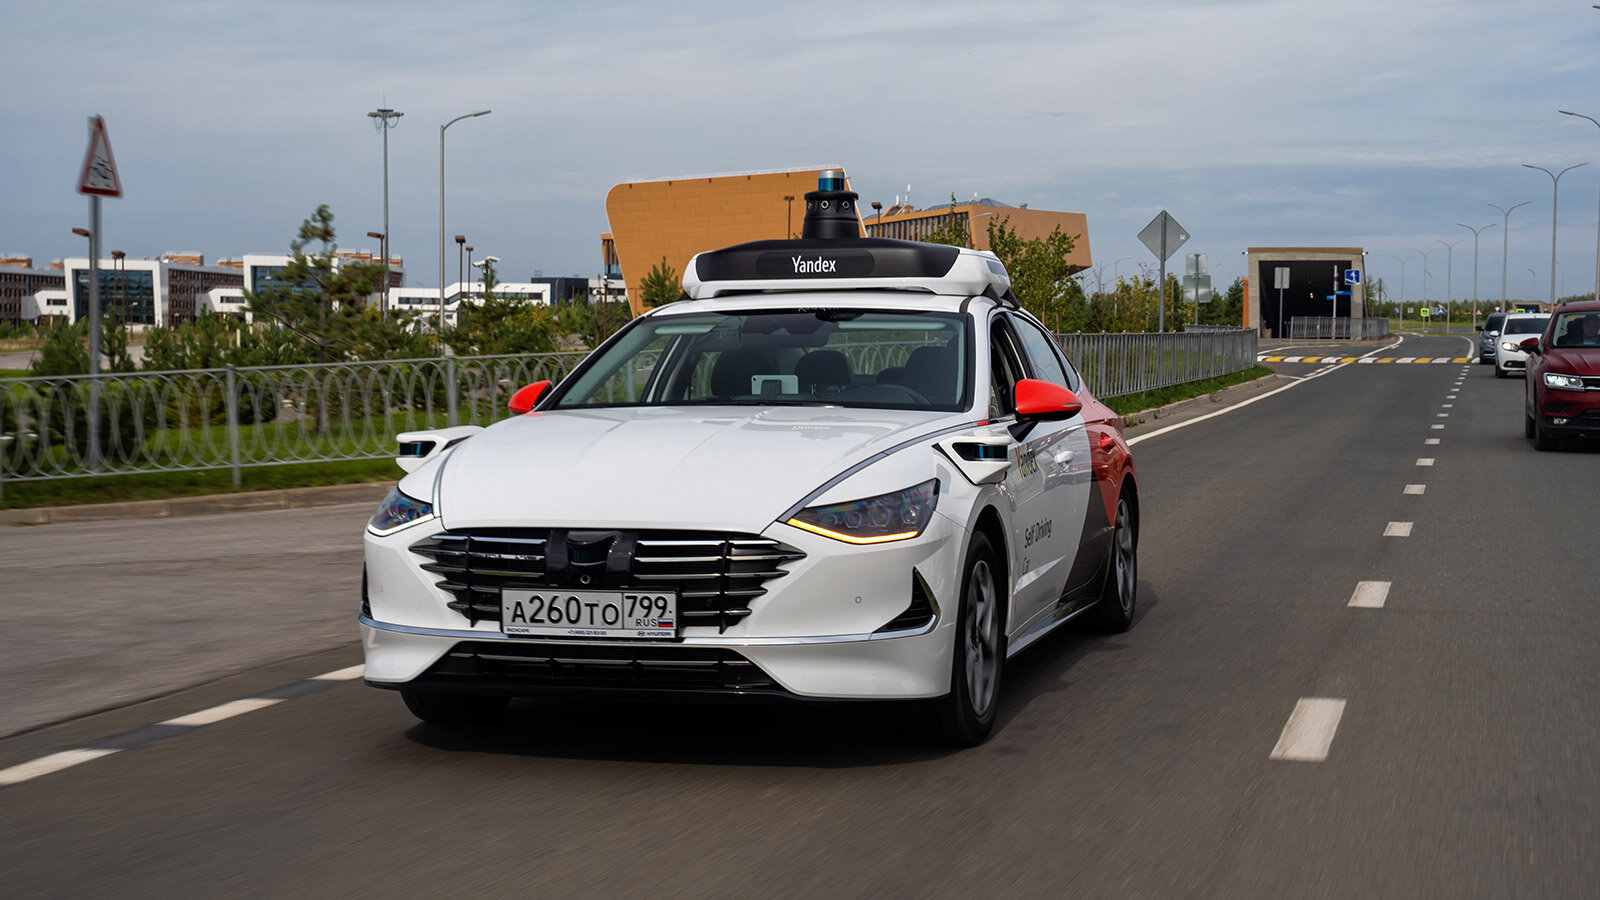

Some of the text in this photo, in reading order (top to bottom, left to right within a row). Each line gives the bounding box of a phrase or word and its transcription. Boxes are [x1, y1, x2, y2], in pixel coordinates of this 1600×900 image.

[792, 255, 836, 273] Yandex
[1024, 517, 1053, 549] Self Driving
[511, 595, 668, 626] A260TO 799
[635, 618, 657, 627] RUS
